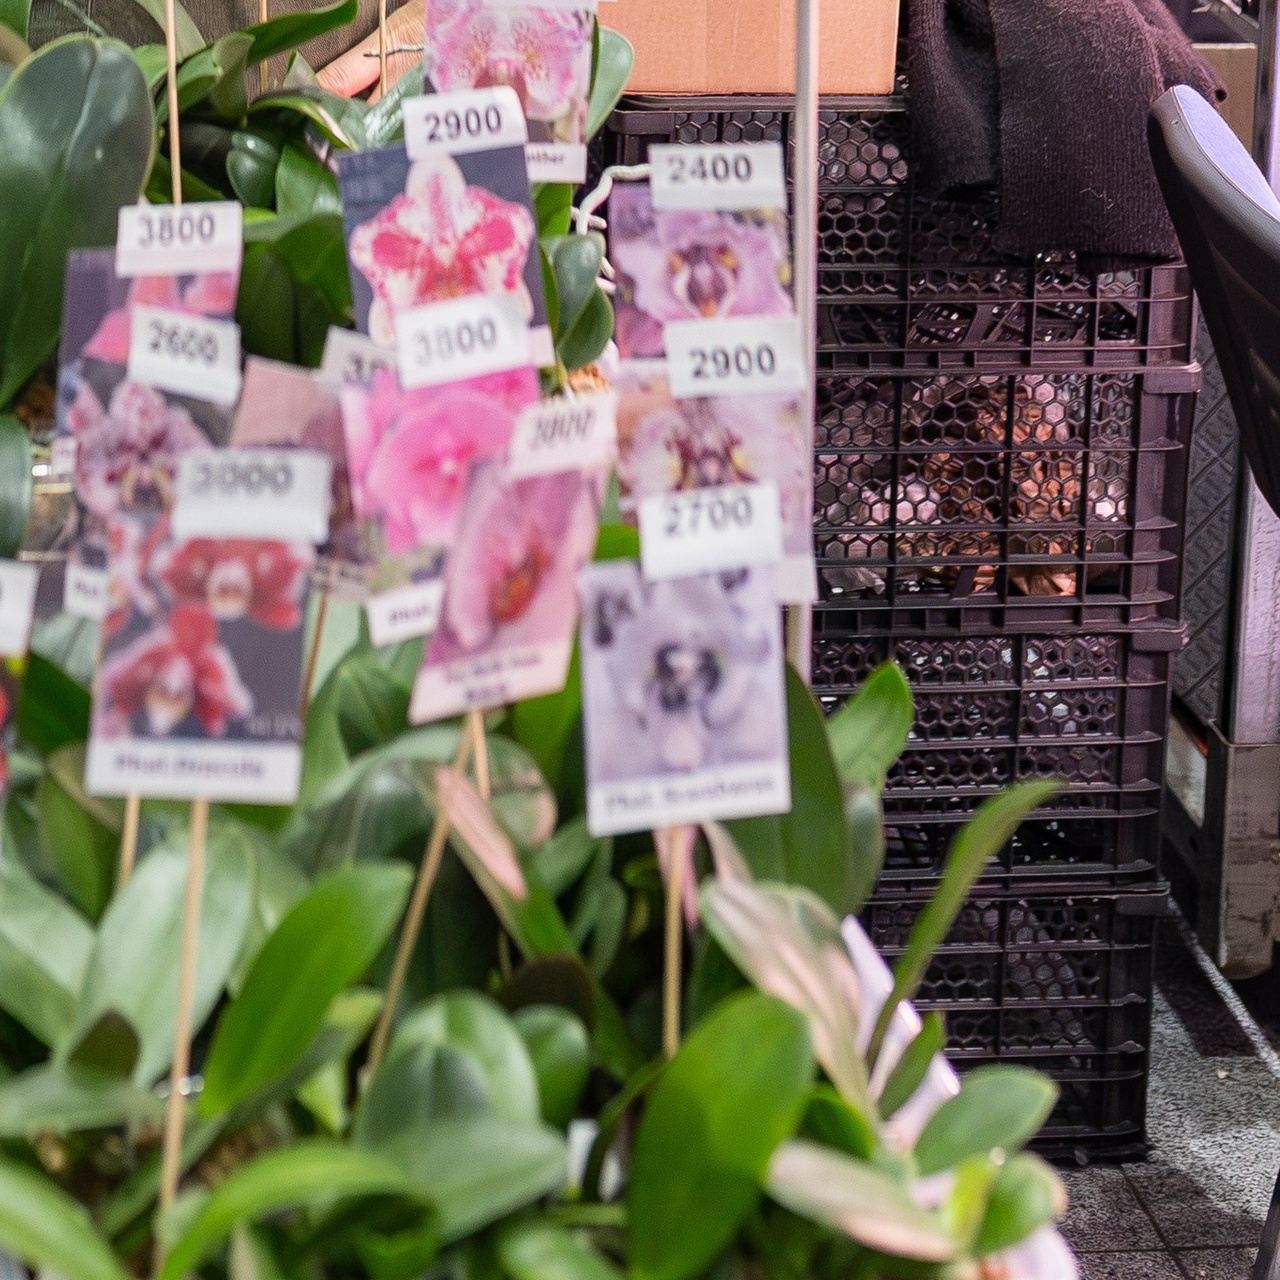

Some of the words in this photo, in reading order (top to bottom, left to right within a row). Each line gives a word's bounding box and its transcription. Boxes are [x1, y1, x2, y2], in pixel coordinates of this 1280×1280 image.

[425, 105, 502, 143] 2900
[668, 154, 752, 183] 2400
[139, 214, 215, 244] 3800
[690, 346, 776, 381] 2900
[664, 492, 753, 537] 2700
